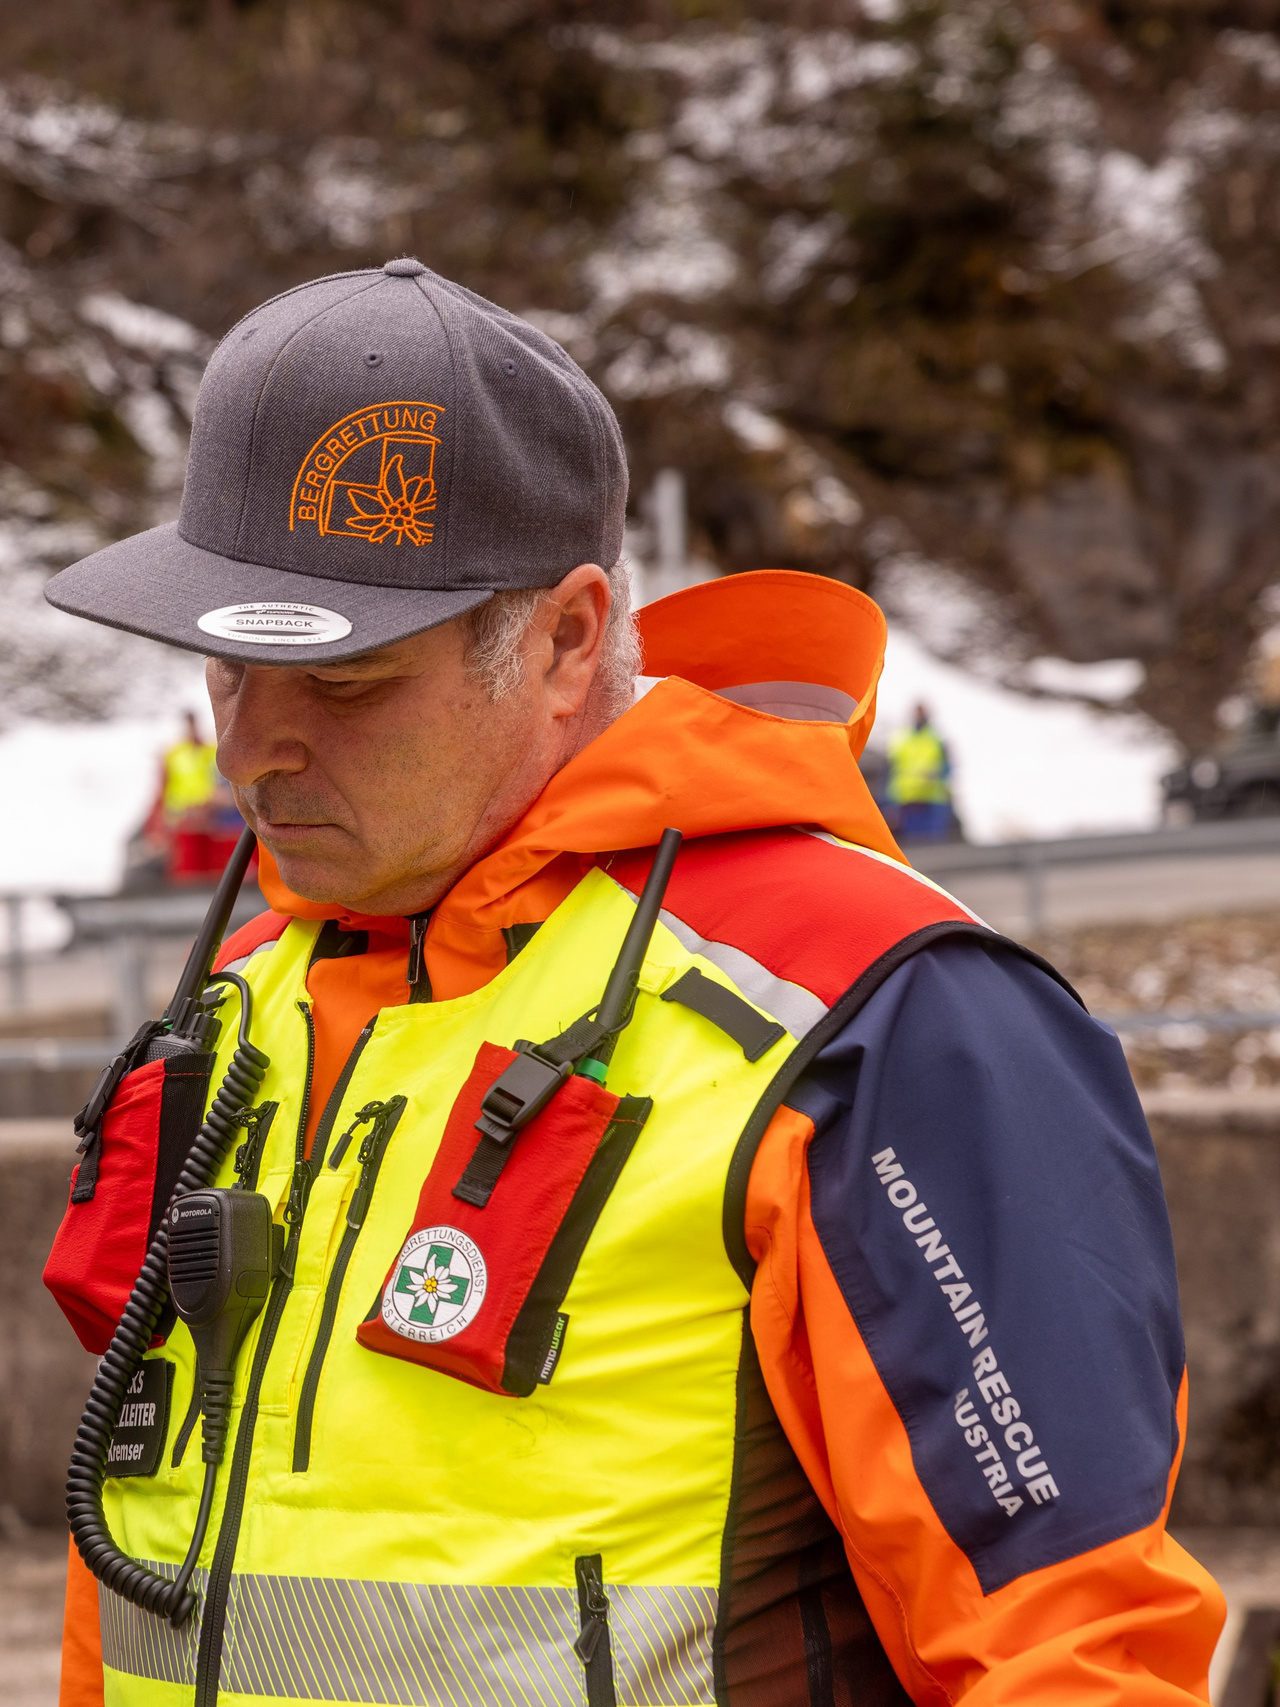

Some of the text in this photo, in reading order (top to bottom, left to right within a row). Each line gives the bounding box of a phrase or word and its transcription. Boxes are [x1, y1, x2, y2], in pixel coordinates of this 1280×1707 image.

[297, 408, 437, 521] BERGRETTUNG
[236, 618, 314, 628] SNAPBACK
[261, 603, 315, 612] AUTHENTIC
[180, 1208, 212, 1218] MOTOROLA
[393, 1228, 486, 1296] GRETTUNGSDIENST
[871, 1146, 1061, 1506] MOUNTAIN RESCUE
[954, 1387, 1024, 1518] AUSTRIA
